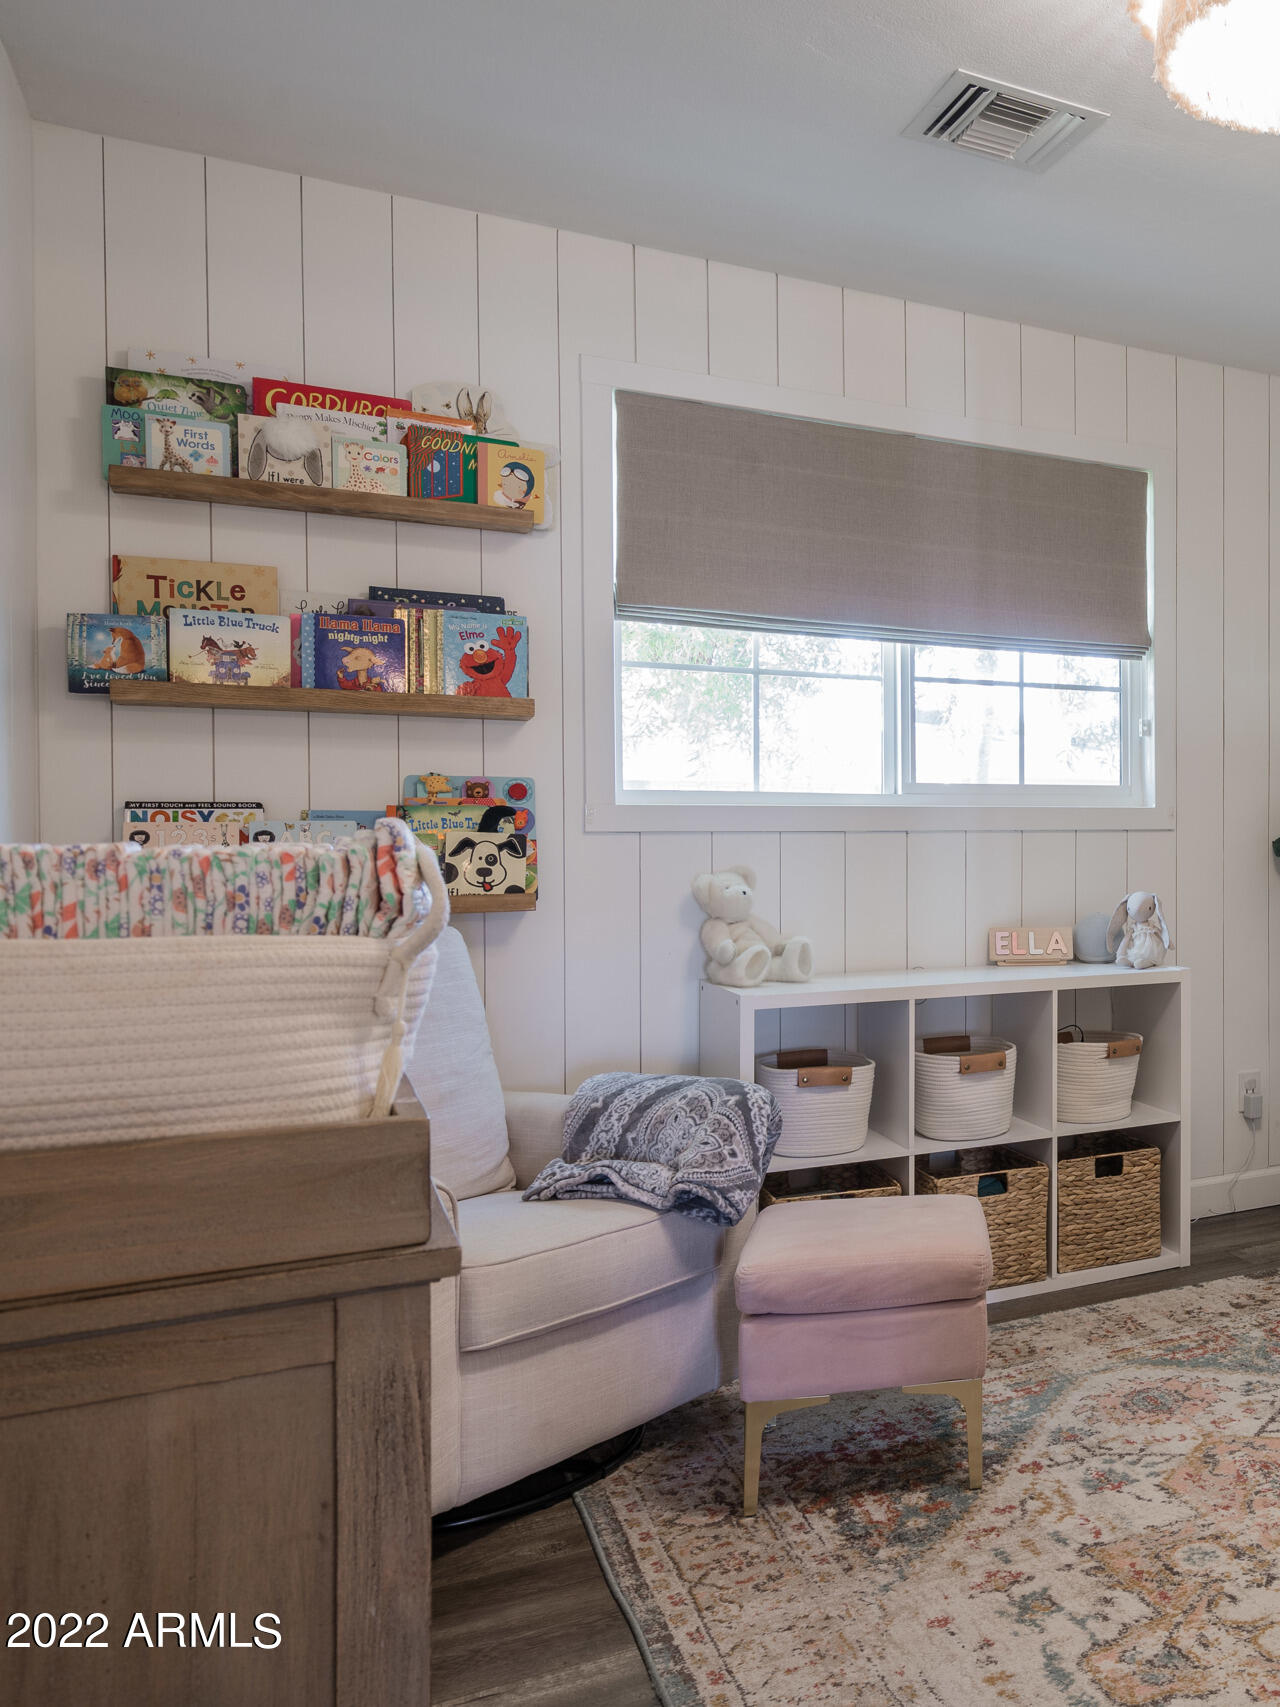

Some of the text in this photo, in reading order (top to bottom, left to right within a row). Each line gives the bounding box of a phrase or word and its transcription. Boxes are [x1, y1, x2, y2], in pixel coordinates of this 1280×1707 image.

[265, 388, 402, 418] CORDURO
[315, 413, 342, 425] Makes
[342, 417, 378, 433] Mischief
[184, 429, 209, 441] First
[176, 438, 216, 451] Words
[421, 435, 477, 455] GOODNI
[363, 451, 399, 464] Colors
[283, 476, 305, 485] were
[183, 614, 280, 633] Little Blue Truck
[319, 616, 401, 634] llama llama
[328, 631, 389, 644] nighty-night
[459, 631, 486, 641] Elmo
[137, 672, 158, 681] You
[130, 810, 215, 823] NOISY
[408, 817, 439, 833] Little
[440, 817, 465, 830] Blue
[995, 931, 1068, 955] ELLA
